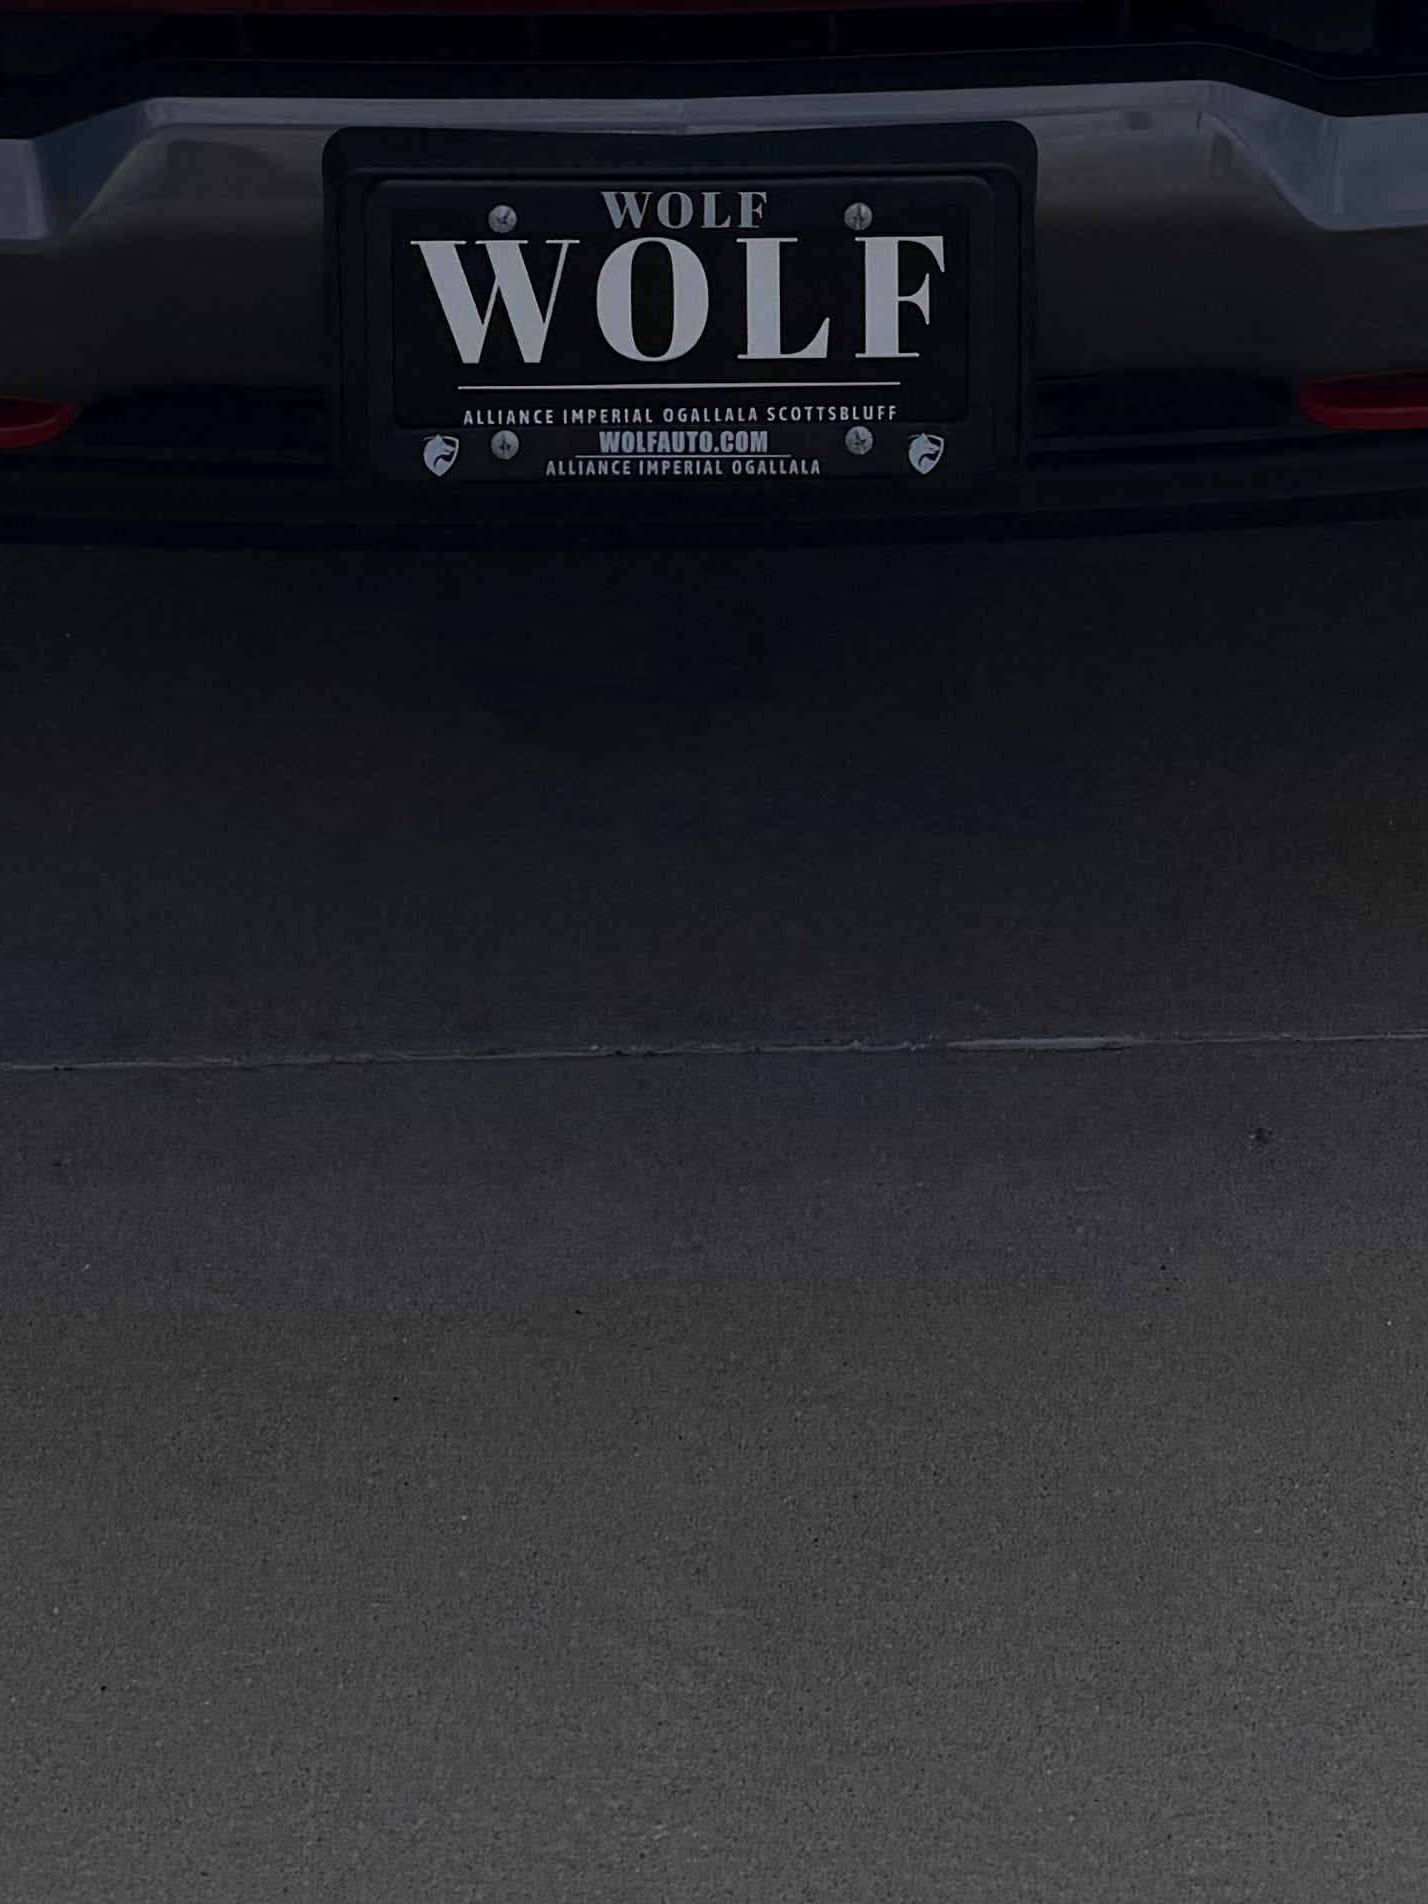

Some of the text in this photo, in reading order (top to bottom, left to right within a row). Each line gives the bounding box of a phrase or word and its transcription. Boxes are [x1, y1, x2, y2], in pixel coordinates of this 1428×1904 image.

[600, 190, 768, 230] WOLF
[410, 235, 946, 365] WOLF
[463, 405, 898, 426] ALLIANCE IMPERIAL OGALLALA SCOTTSBLUFF
[599, 430, 768, 454] WOLFAUTO.COM
[545, 459, 821, 476] ALLIANCE IMPERIAL OGALLALA
